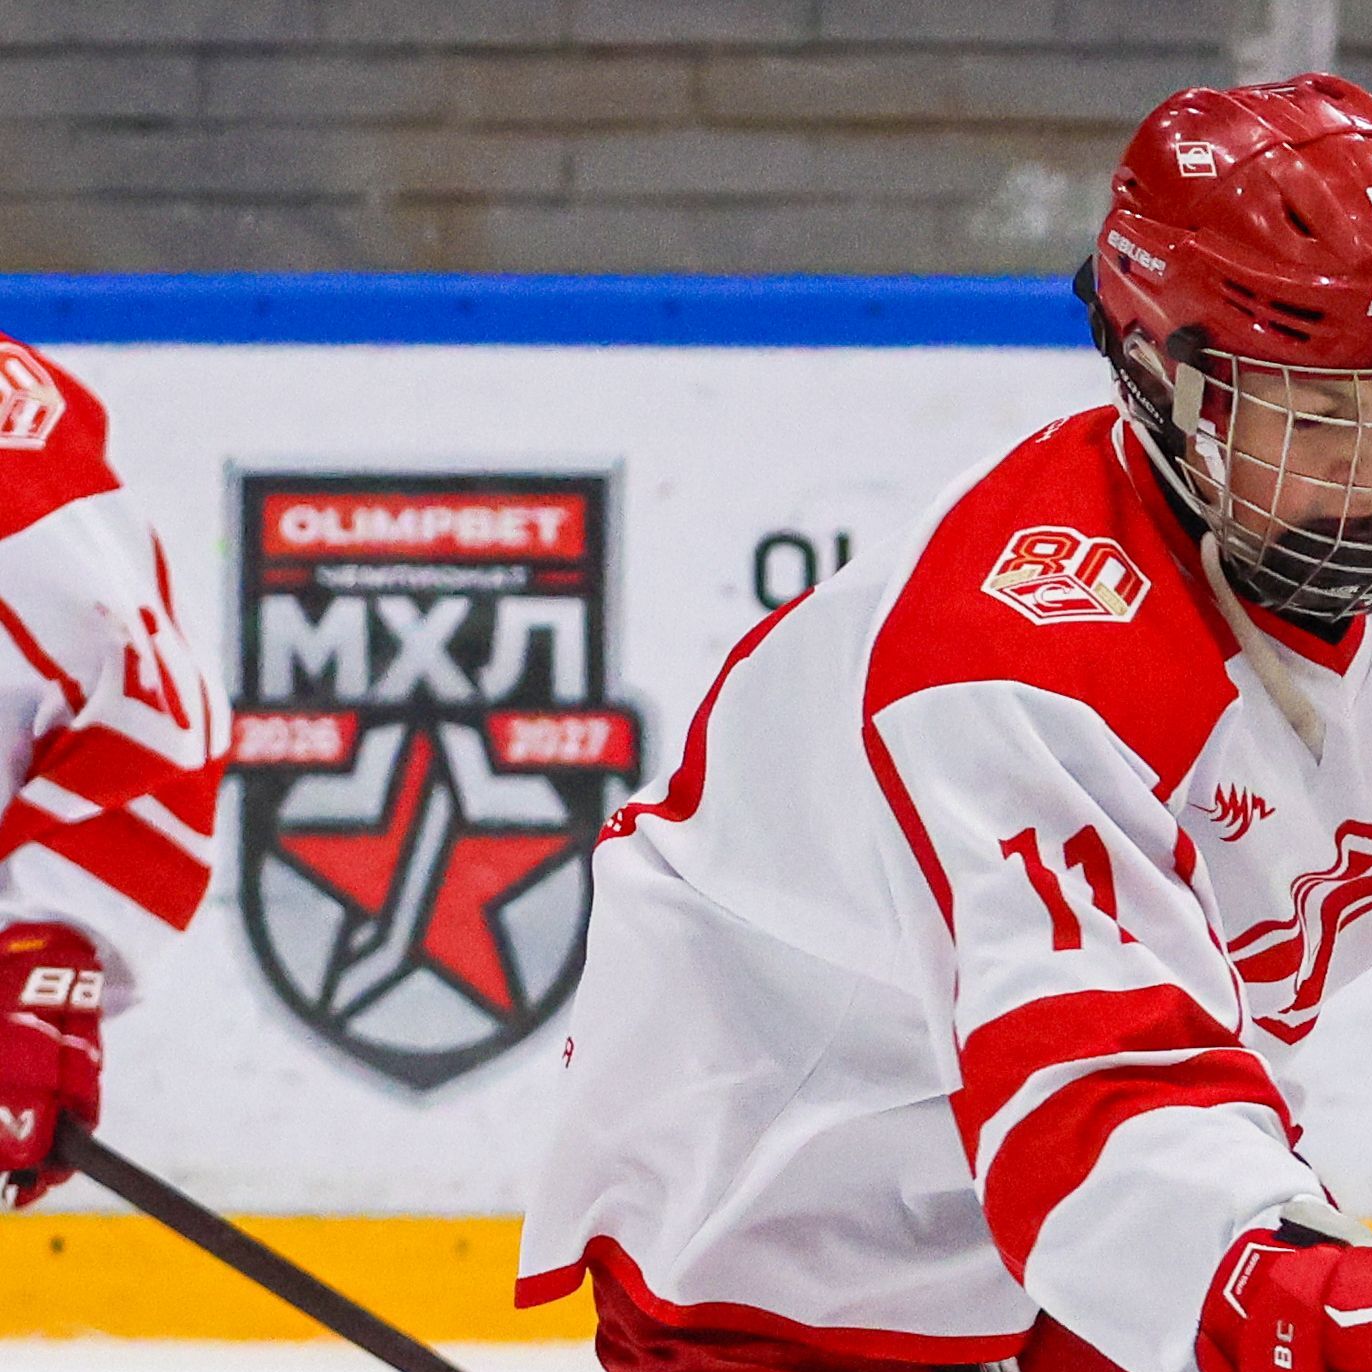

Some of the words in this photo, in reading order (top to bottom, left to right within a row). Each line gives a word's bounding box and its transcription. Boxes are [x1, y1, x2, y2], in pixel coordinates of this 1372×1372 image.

[280, 505, 567, 547] OLIMPBET
[258, 596, 588, 702] МХЛ
[998, 823, 1139, 951] 11
